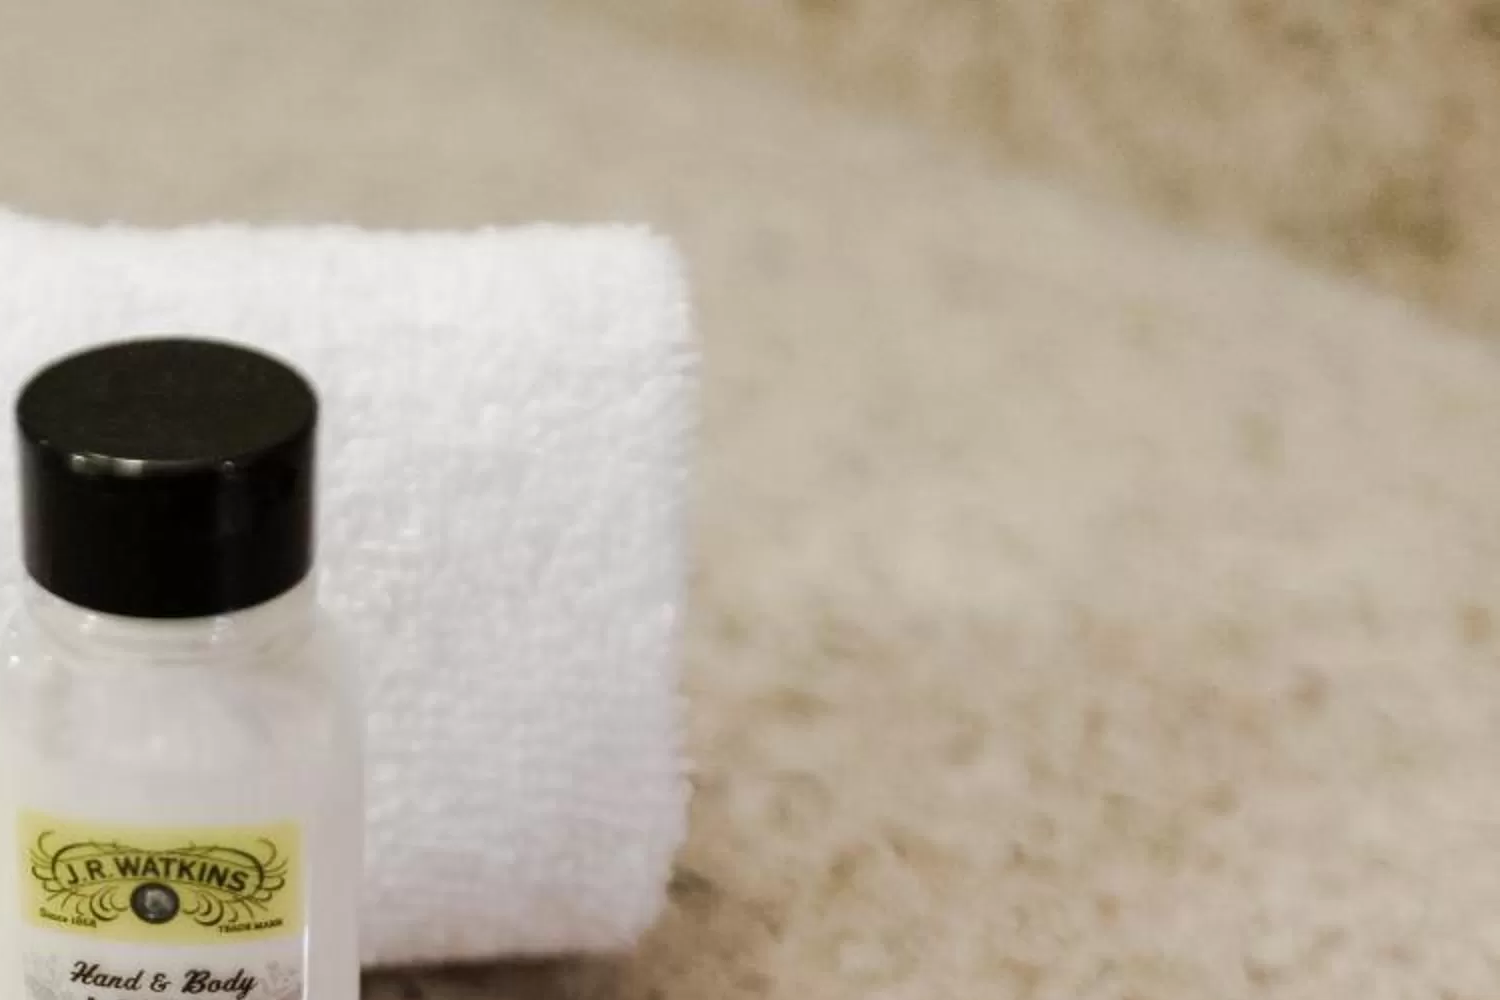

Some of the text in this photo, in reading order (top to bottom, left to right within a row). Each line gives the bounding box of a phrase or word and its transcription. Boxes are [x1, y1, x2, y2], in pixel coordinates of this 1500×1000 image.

[114, 856, 249, 892] WATKINS
[70, 960, 257, 1000] Hand & Body
